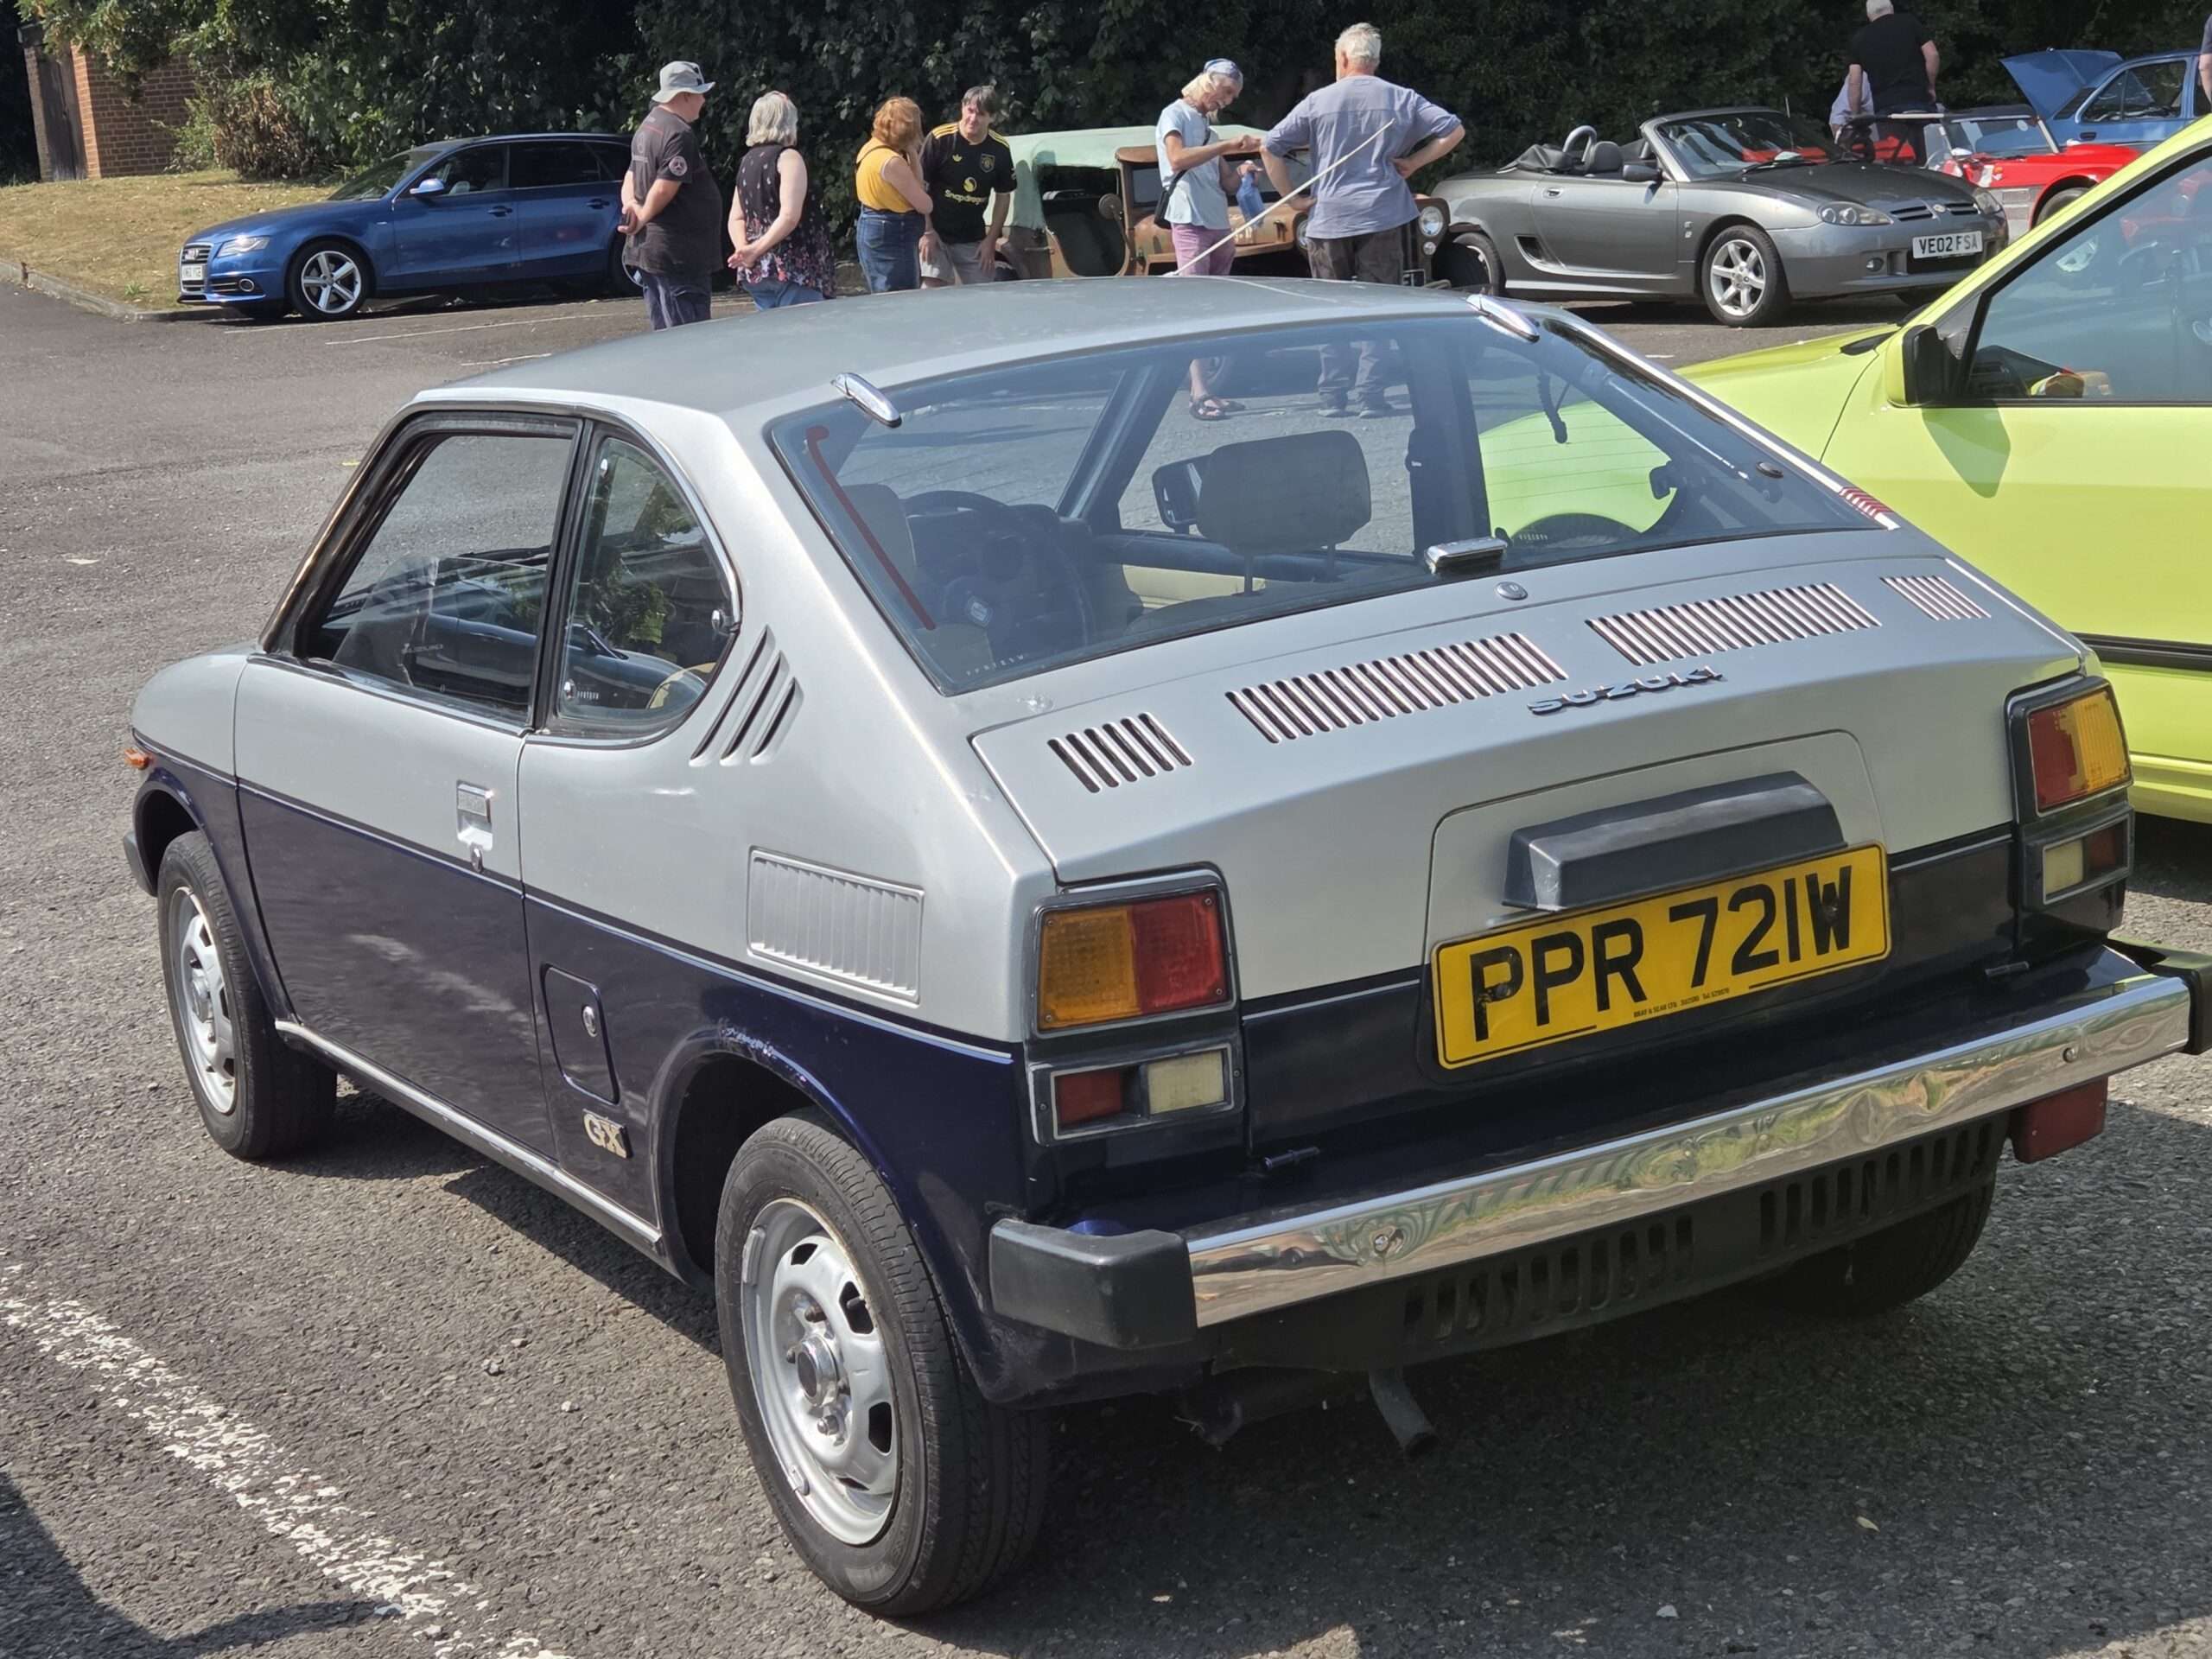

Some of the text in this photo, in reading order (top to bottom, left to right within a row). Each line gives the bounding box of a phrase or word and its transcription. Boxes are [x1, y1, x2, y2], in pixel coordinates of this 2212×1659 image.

[1955, 234, 1978, 251] FSA
[1527, 666, 1724, 715] SUZUKI
[1469, 866, 1852, 1042] PPR 721W
[583, 1113, 627, 1159] GX
